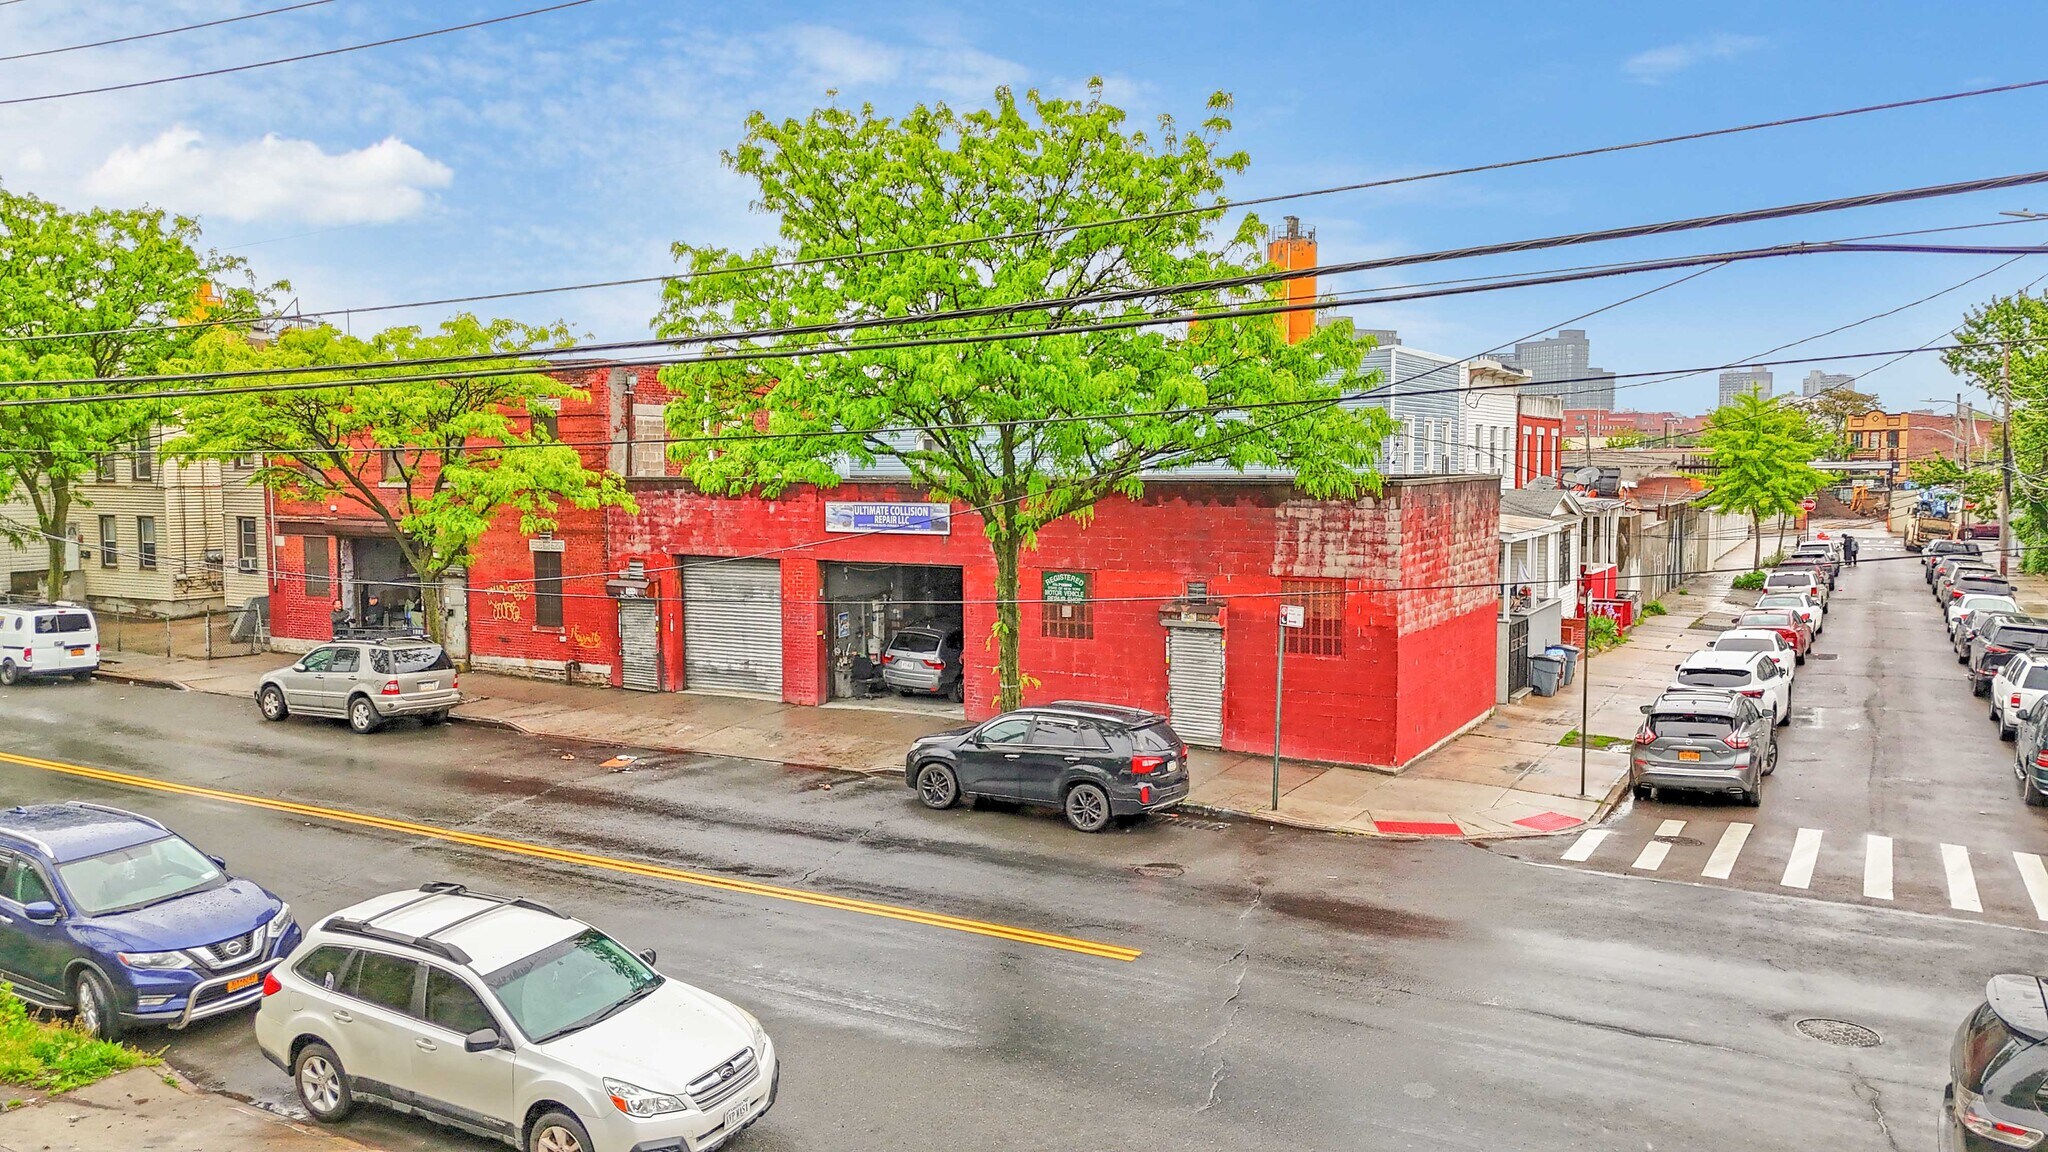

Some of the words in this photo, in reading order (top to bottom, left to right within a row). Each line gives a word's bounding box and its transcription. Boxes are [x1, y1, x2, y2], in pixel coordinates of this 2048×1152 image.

[854, 506, 889, 515] ULTIMATE
[890, 506, 929, 516] COLLISION
[874, 515, 897, 524] REPAIR
[898, 516, 909, 525] LLC
[1045, 574, 1084, 587] REGISTERED
[1063, 590, 1084, 598] VEHICLE
